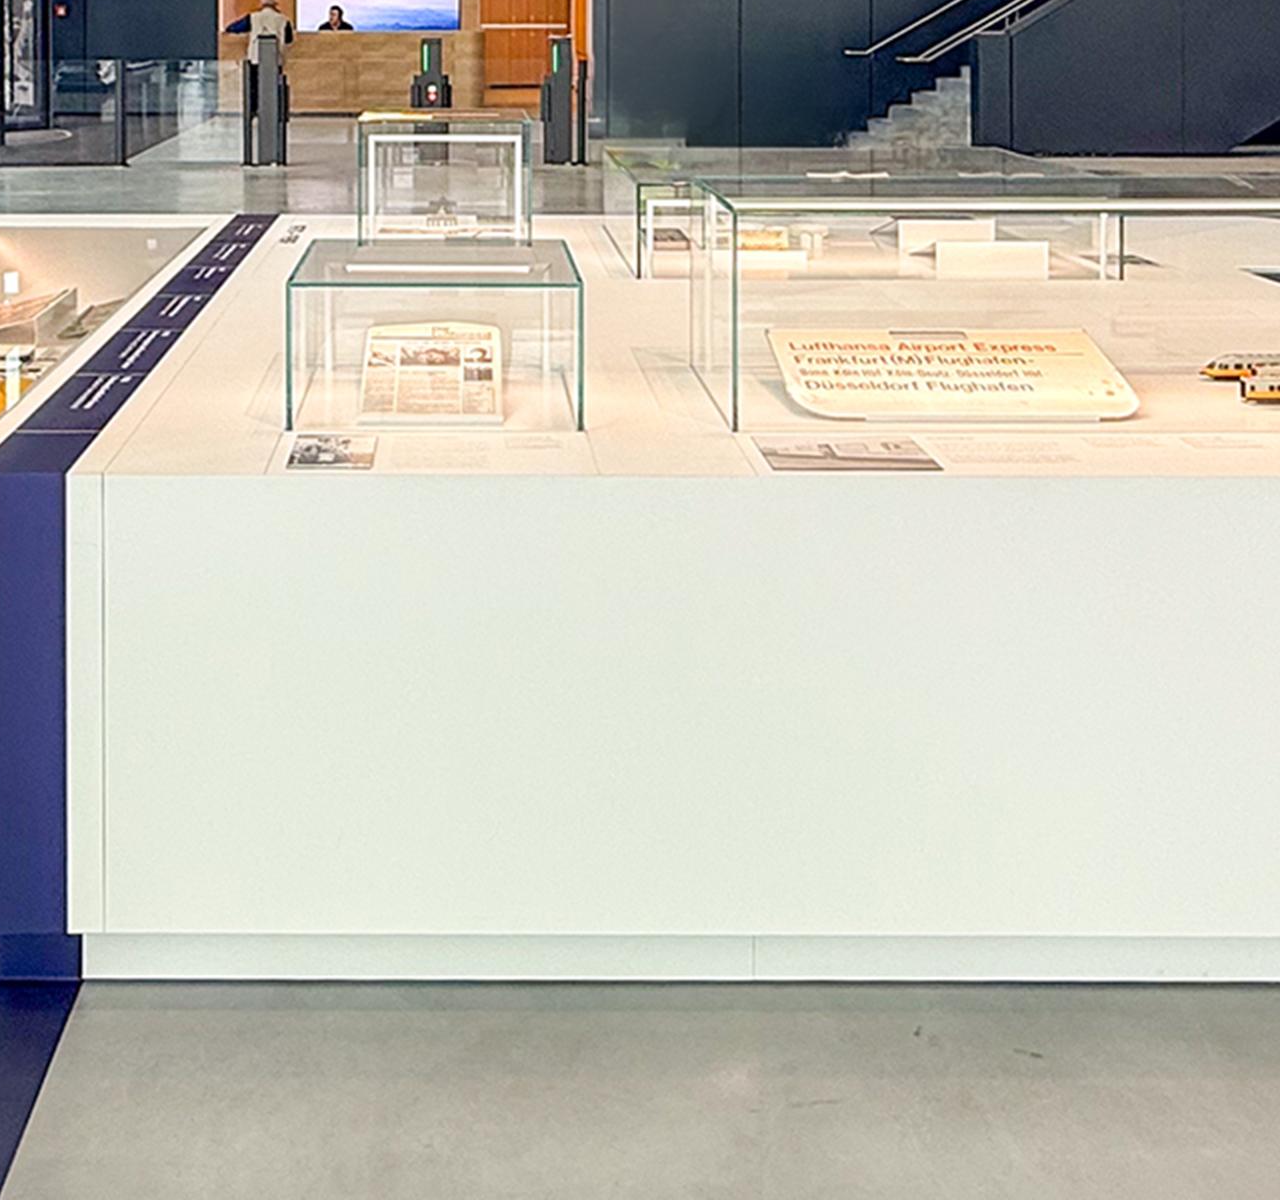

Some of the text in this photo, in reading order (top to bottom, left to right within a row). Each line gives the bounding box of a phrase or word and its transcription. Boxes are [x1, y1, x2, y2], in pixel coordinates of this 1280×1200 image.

[788, 341, 1057, 353] Lufthansa Airport Express
[804, 380, 1034, 393] Düsseldorf Flughafen
